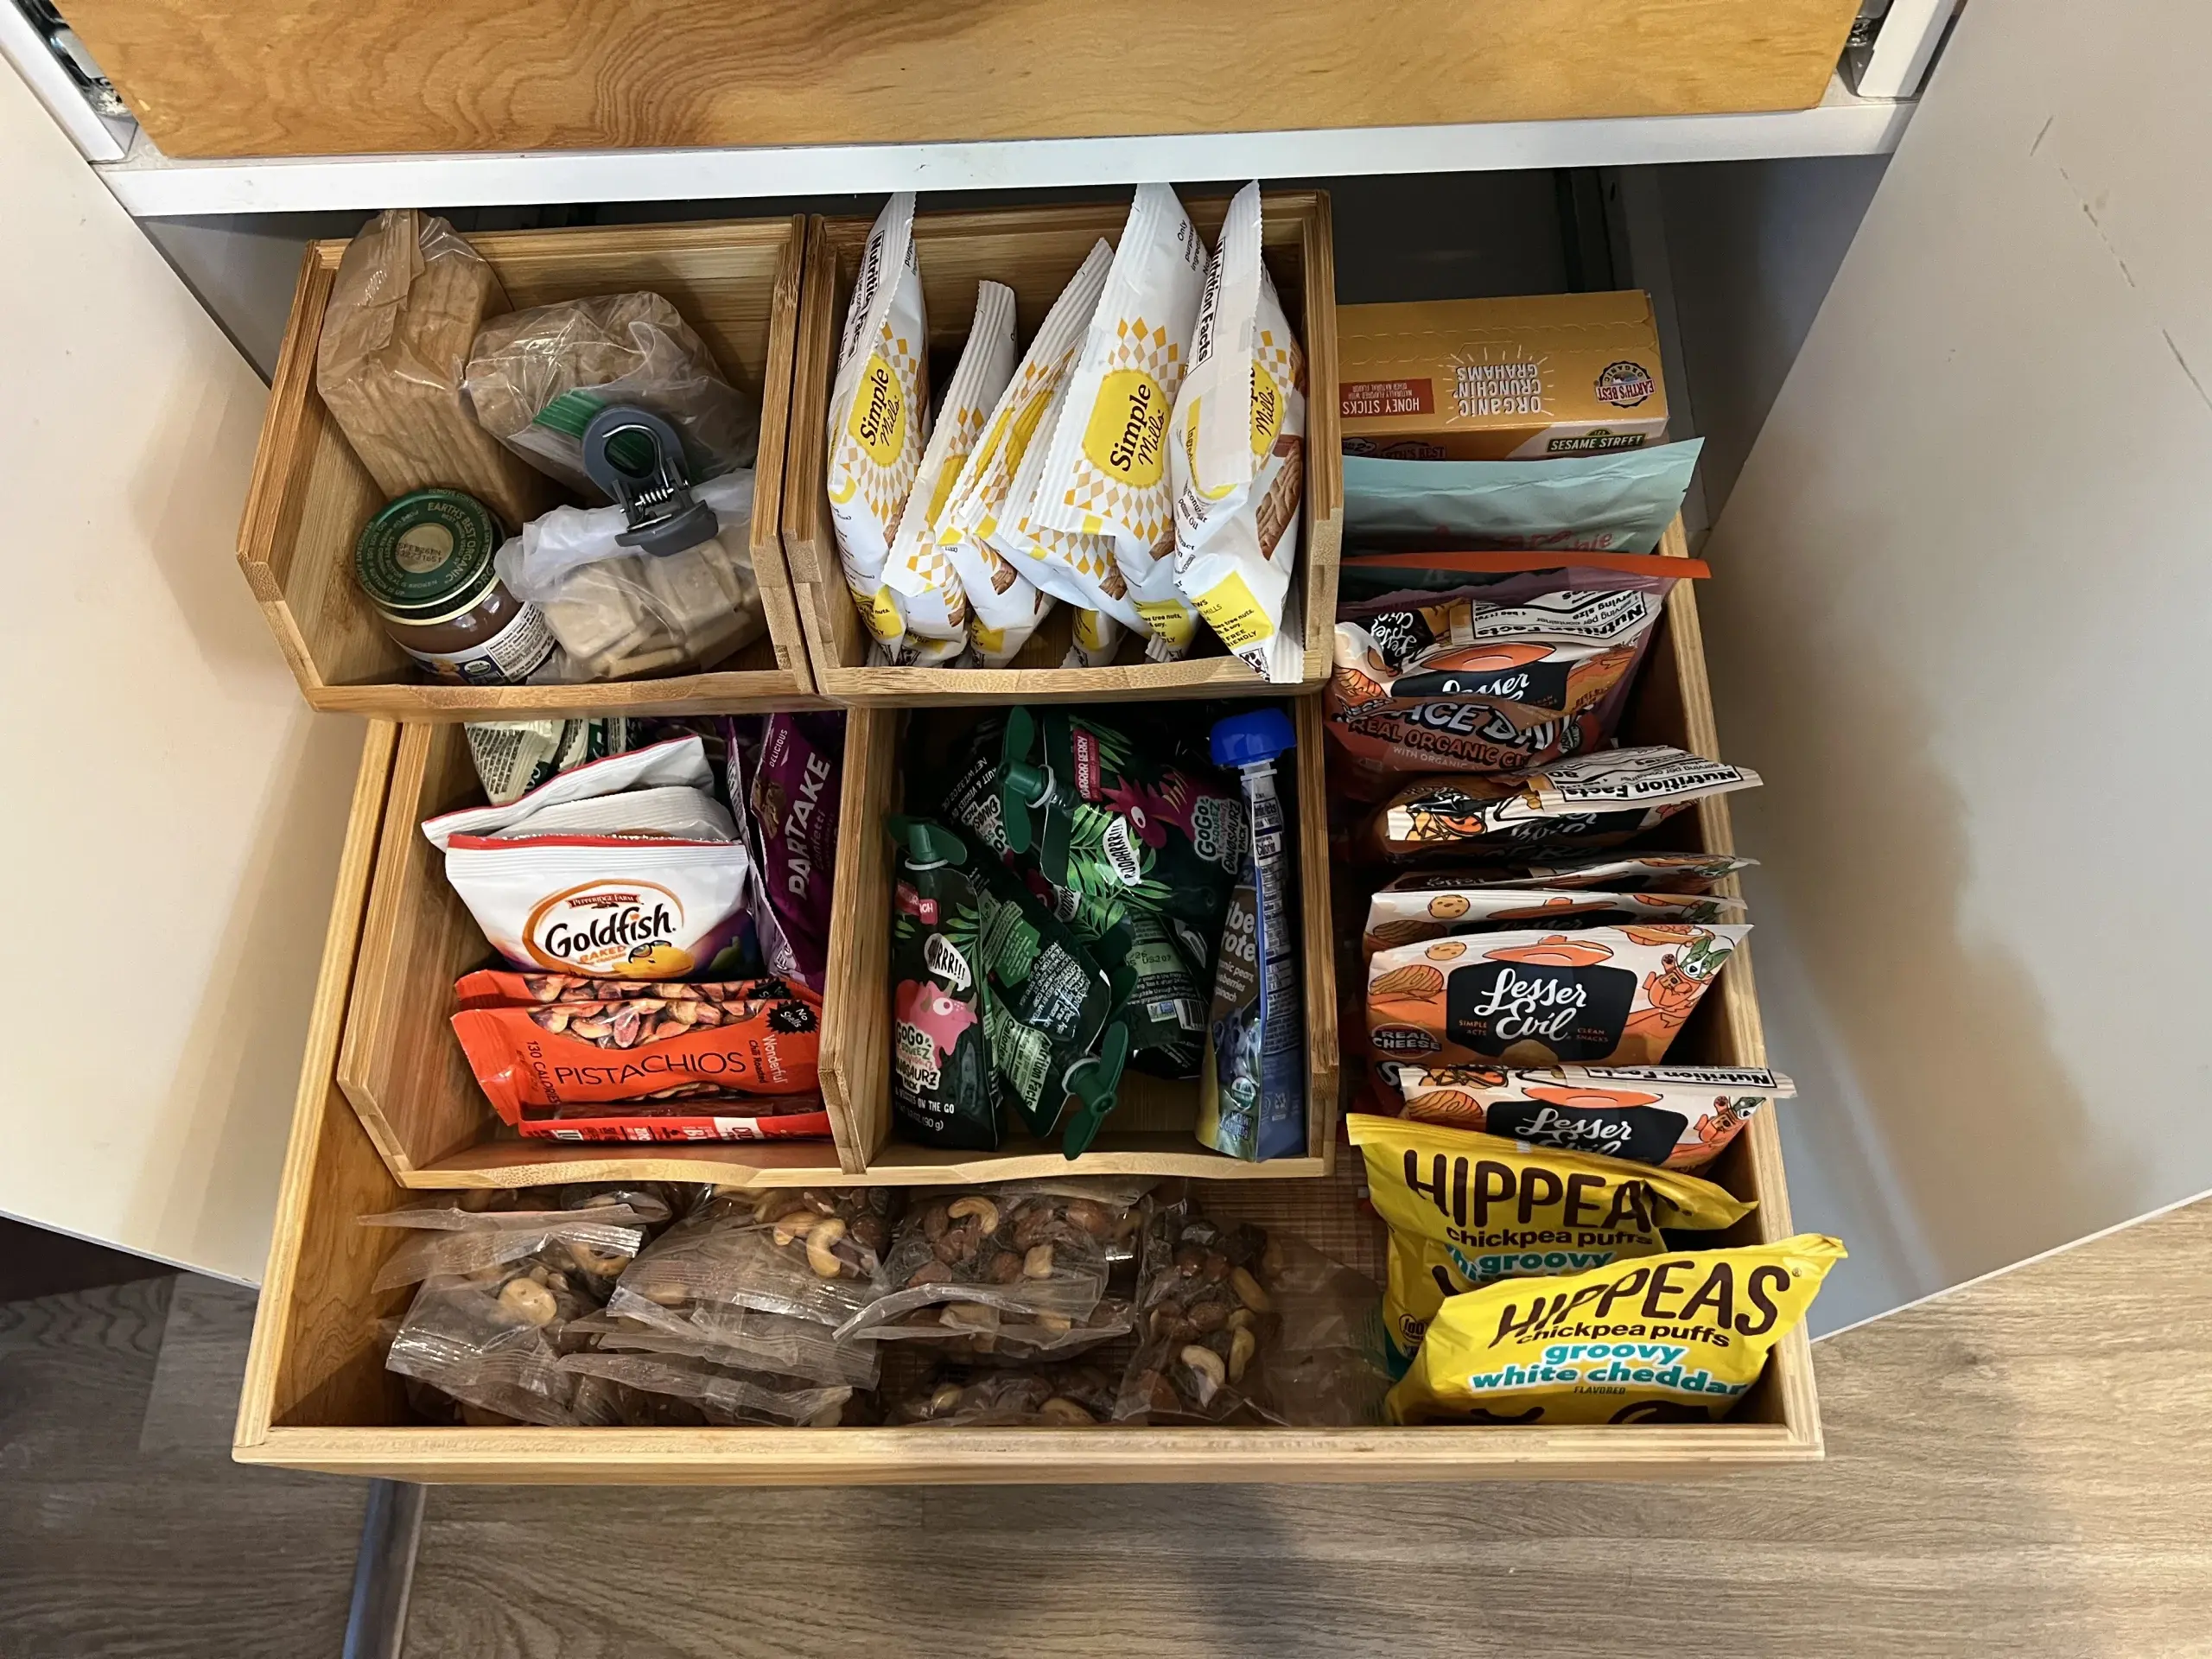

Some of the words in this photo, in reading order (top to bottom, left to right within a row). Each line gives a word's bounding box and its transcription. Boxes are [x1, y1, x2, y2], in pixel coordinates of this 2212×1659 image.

[1178, 219, 1187, 241] Only
[1198, 312, 1214, 362] Facts
[1456, 363, 1539, 380] GRAHAMS
[1599, 386, 1619, 400] BEST
[1620, 380, 1655, 399] EARTH'S
[861, 369, 889, 447] Simple
[1255, 387, 1274, 436] Mills
[1342, 398, 1380, 415] STICKS
[1385, 397, 1420, 413] HONEY
[880, 395, 899, 446] Mills
[1109, 384, 1151, 472] Simple
[1138, 409, 1165, 466] Mills
[1550, 438, 1597, 451] SESAME
[1599, 435, 1643, 448] STREET
[463, 517, 476, 537] BEST
[1188, 516, 1198, 530] Oil
[445, 539, 476, 582] ORGANIC
[1598, 590, 1637, 611] erving
[1226, 628, 1247, 641] FREE
[770, 728, 788, 767] DELICIOUS
[1077, 735, 1089, 762] BERRY
[1351, 718, 1403, 742] REAL
[1406, 729, 1500, 766] ORGANIC
[1393, 746, 1419, 760] WITH
[1420, 753, 1468, 770] ORGANIC
[1564, 785, 1630, 798] Facts
[1637, 771, 1738, 792] Nutrition
[785, 752, 832, 899] PARTAKE
[545, 903, 674, 958] Goldfish
[1474, 968, 1587, 1016] Lesser
[796, 1007, 809, 1021] No
[1459, 1020, 1487, 1028] SIMPLE
[1496, 997, 1577, 1041] Evil
[998, 1018, 1015, 1062] Calories
[1372, 1037, 1441, 1051] CHEESE
[1381, 1030, 1431, 1041] REAL
[526, 1040, 543, 1058] 130
[762, 1034, 788, 1084] Wonderful
[555, 1052, 747, 1086] PISTACHIOS
[1663, 1070, 1771, 1085] Nutrition
[532, 1061, 563, 1104] CALORIES
[1024, 1079, 1043, 1107] Facts
[928, 1099, 942, 1113] THE
[944, 1103, 956, 1115] GO
[1515, 1107, 1632, 1141] Lesser
[1446, 1227, 1573, 1249] chickpea
[1478, 1252, 1618, 1274] groovy
[1488, 1261, 1791, 1350] HIPPEAS
[1515, 1323, 1647, 1347] chickpea
[1652, 1323, 1732, 1348] puffs
[1544, 1342, 1686, 1367] groovy
[1472, 1362, 1581, 1390] white
[1573, 1386, 1627, 1395] FLAVORED
